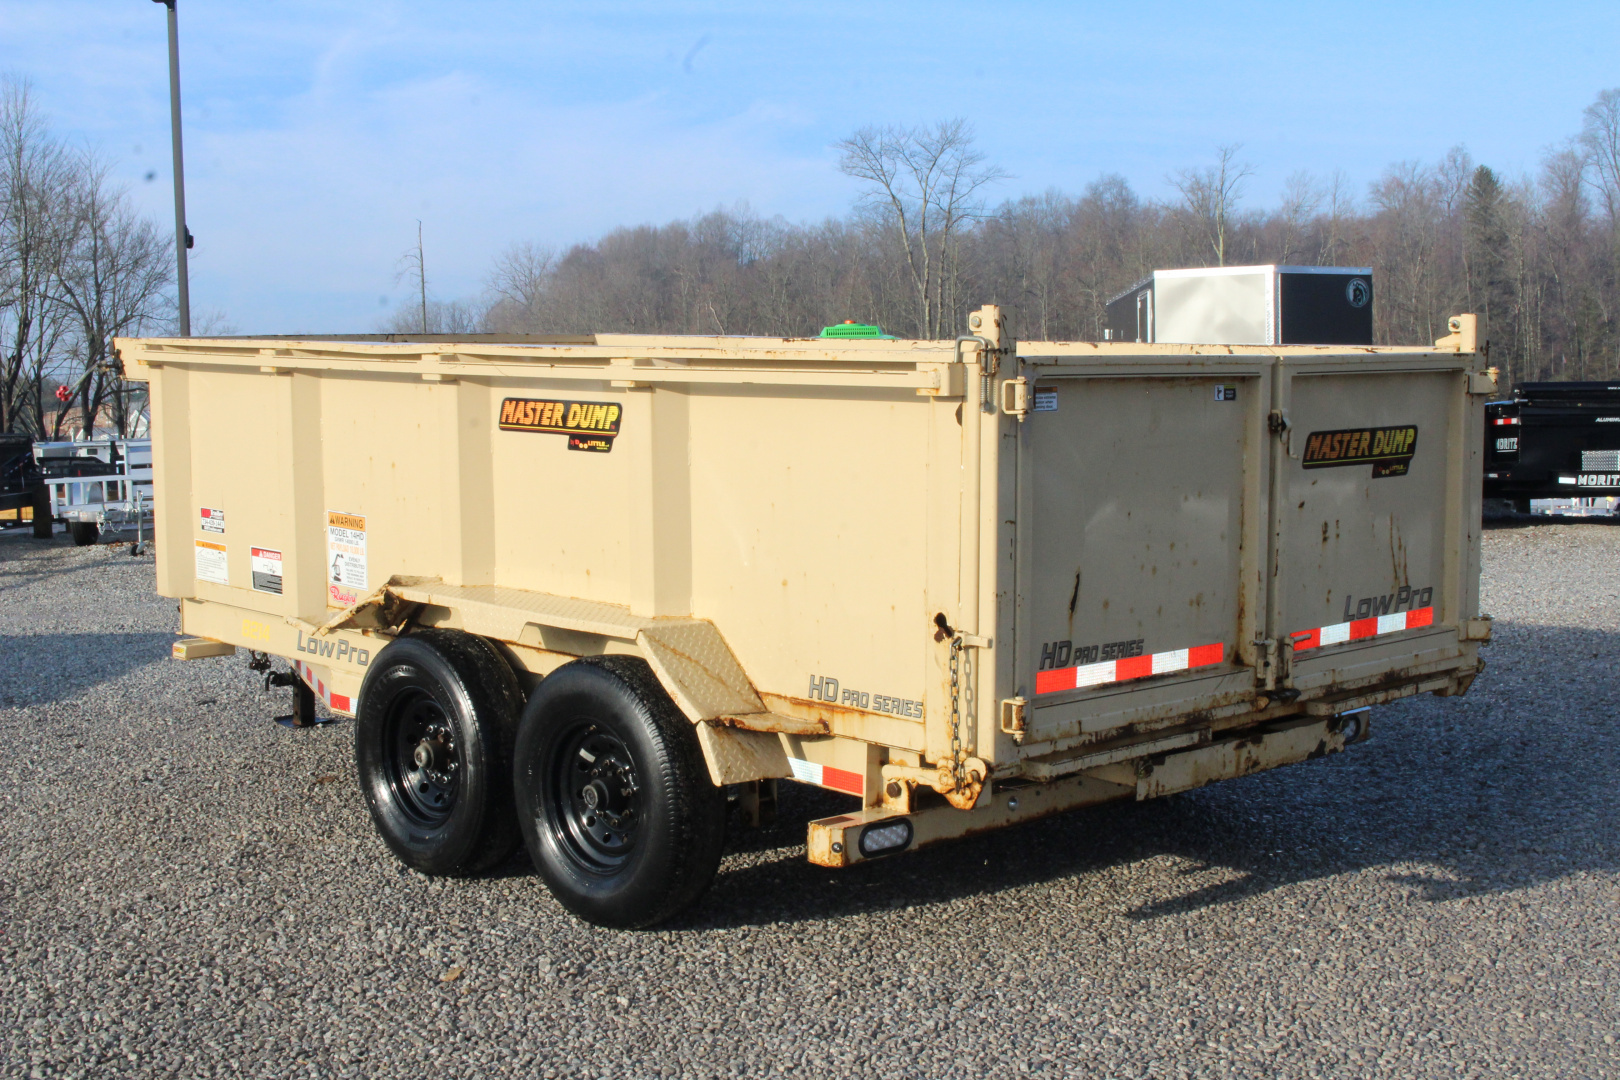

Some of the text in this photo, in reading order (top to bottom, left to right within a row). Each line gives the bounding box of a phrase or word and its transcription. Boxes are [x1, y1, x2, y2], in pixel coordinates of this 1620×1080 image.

[501, 400, 619, 430] MASTER DUMP
[1306, 428, 1415, 460] MASTER DUMP
[1578, 474, 1620, 486] MORIT
[335, 515, 363, 529] WARNING
[330, 527, 365, 541] MODEL 14HD
[263, 550, 281, 561] DANGER
[241, 619, 271, 642] 8214
[1039, 638, 1145, 671] HD PRO SERIES
[808, 674, 924, 718] HD PRO SERIES
